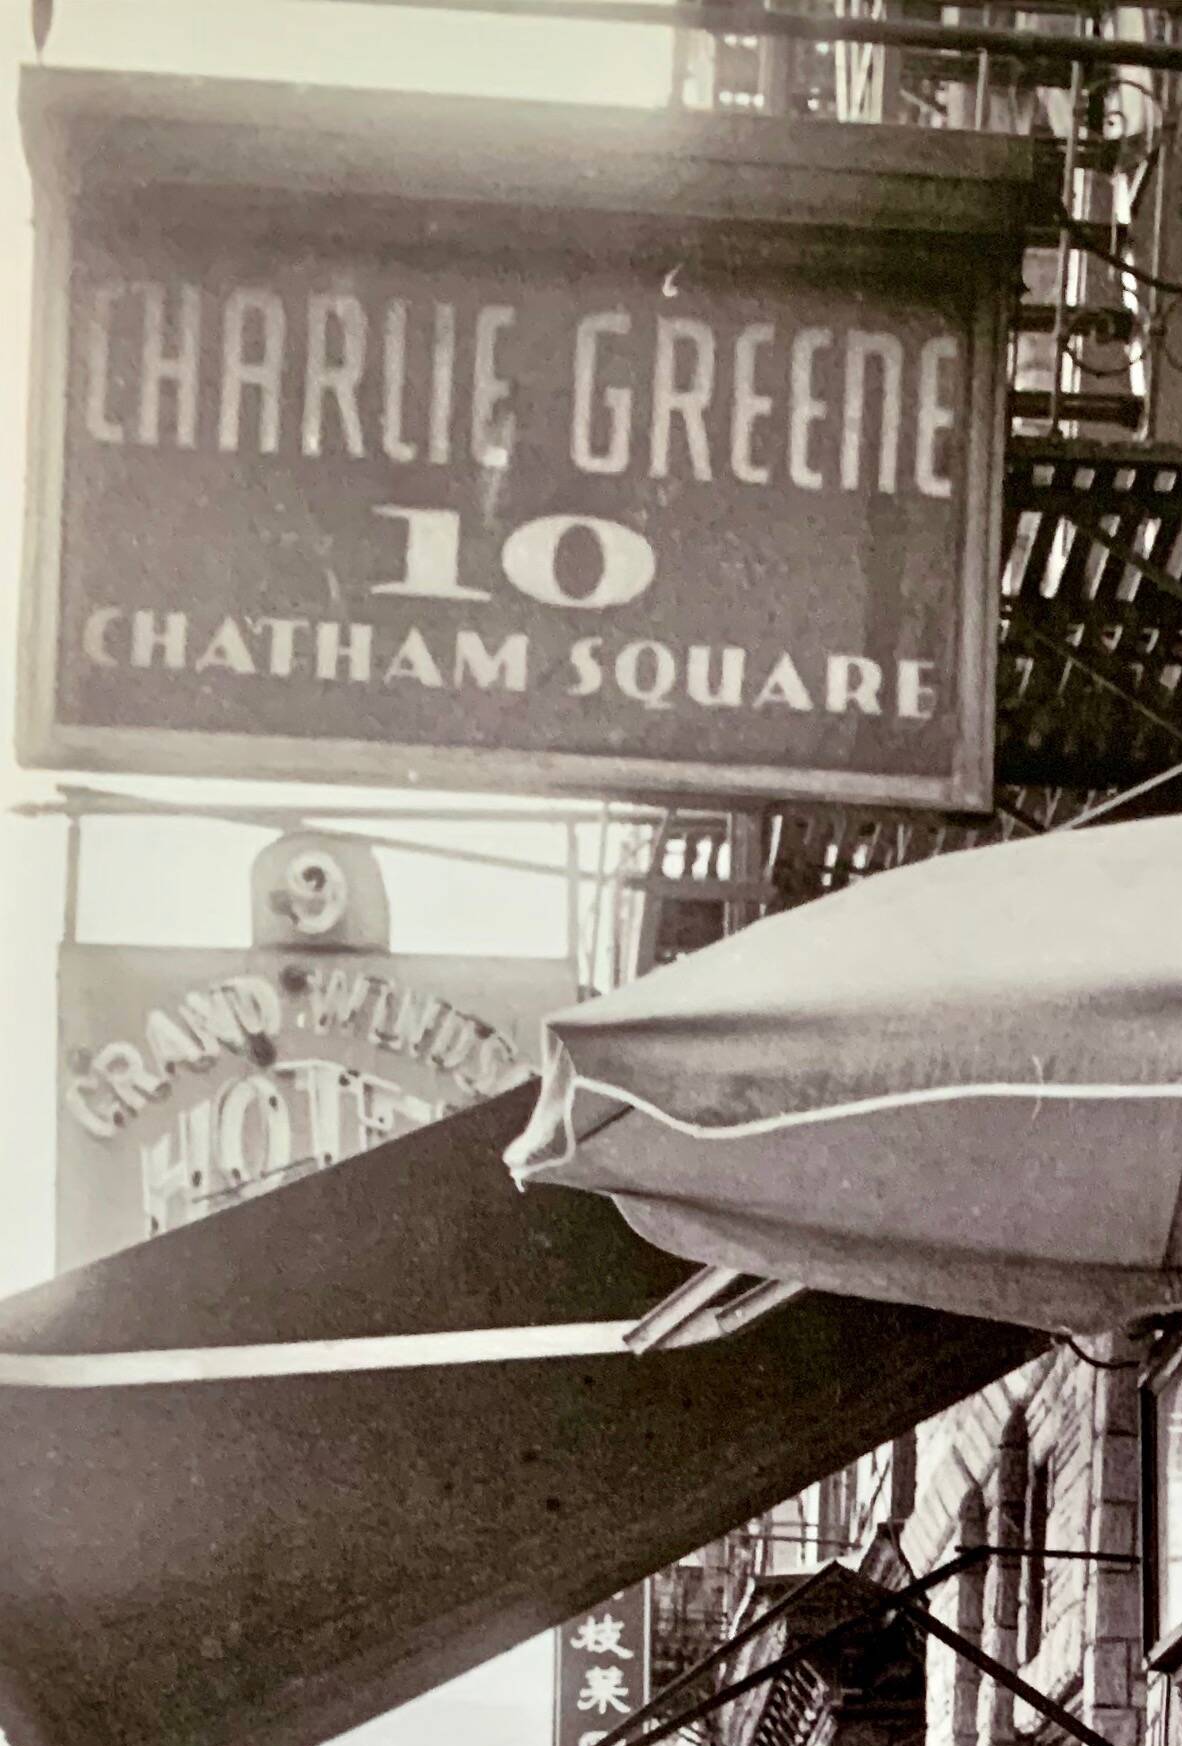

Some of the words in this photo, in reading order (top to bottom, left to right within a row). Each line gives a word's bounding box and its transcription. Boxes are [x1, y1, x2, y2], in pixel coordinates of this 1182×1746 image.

[85, 280, 516, 468] CHARLIE
[569, 310, 959, 498] GREENE
[370, 505, 657, 609] 10
[83, 607, 528, 693] CHATHAM
[568, 635, 938, 722] SQUARE
[66, 975, 282, 1138] GRAND
[307, 967, 542, 1098] WINDS
[140, 1057, 450, 1243] HOTE
